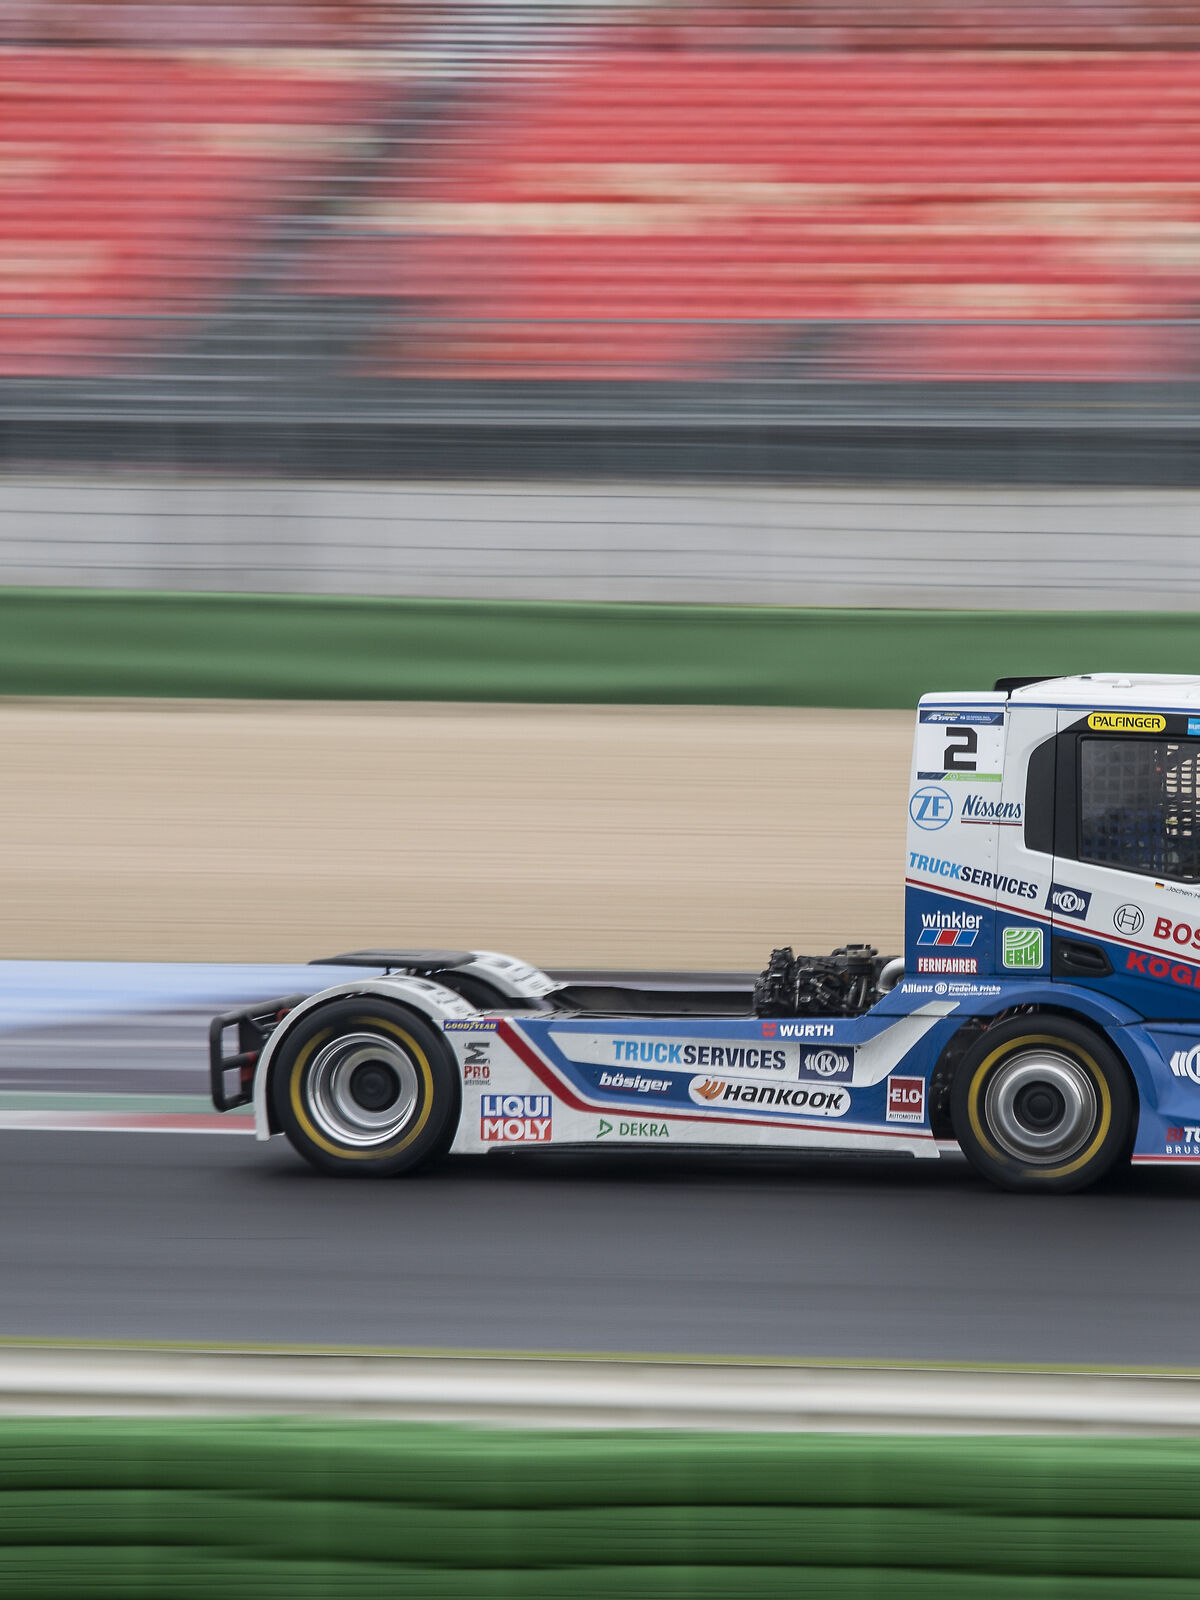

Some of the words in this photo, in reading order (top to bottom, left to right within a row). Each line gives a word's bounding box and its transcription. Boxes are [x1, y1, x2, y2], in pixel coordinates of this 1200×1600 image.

[1093, 716, 1161, 729] PALFINGER
[943, 726, 978, 771] 2
[910, 795, 952, 821] ZF
[961, 794, 1022, 819] Nissens
[909, 851, 1039, 900] TRUCKSERVICES
[921, 910, 983, 929] winkler
[918, 957, 977, 973] FERNFAHRER
[1005, 944, 1041, 967] EBLA
[901, 983, 934, 994] Allianz
[779, 1024, 834, 1037] WÜRTH
[612, 1040, 787, 1071] TRUCKSERVICES
[464, 1065, 490, 1079] PRO
[600, 1072, 673, 1093] bösiger
[892, 1088, 920, 1104] ELO
[484, 1096, 549, 1118] LIQUI
[888, 1113, 922, 1121] AUTOMOTIVE
[483, 1119, 550, 1140] MOLY
[619, 1122, 670, 1137] DEKRA
